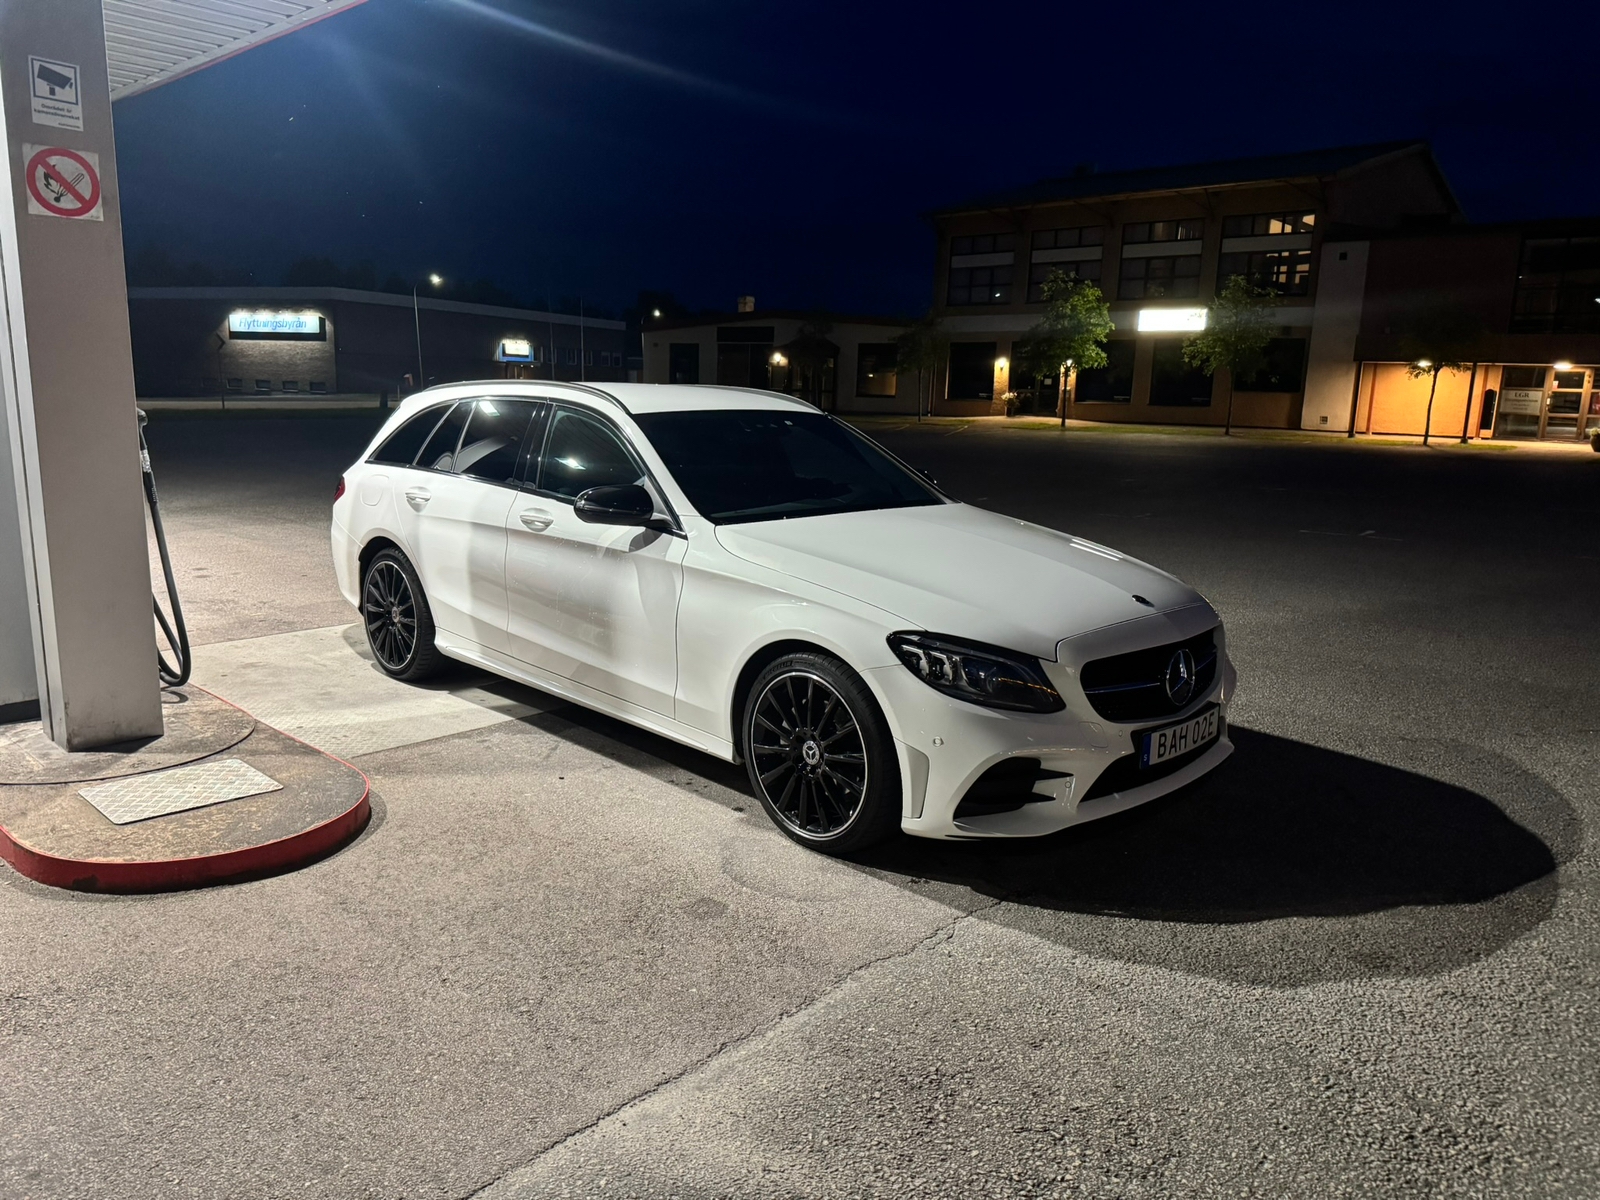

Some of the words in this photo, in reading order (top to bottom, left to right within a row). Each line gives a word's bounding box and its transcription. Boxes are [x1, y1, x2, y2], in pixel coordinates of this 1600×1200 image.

[239, 317, 307, 331] Flyttningsbyrån
[1157, 724, 1189, 759] BAH
[1192, 711, 1215, 745] 02E
